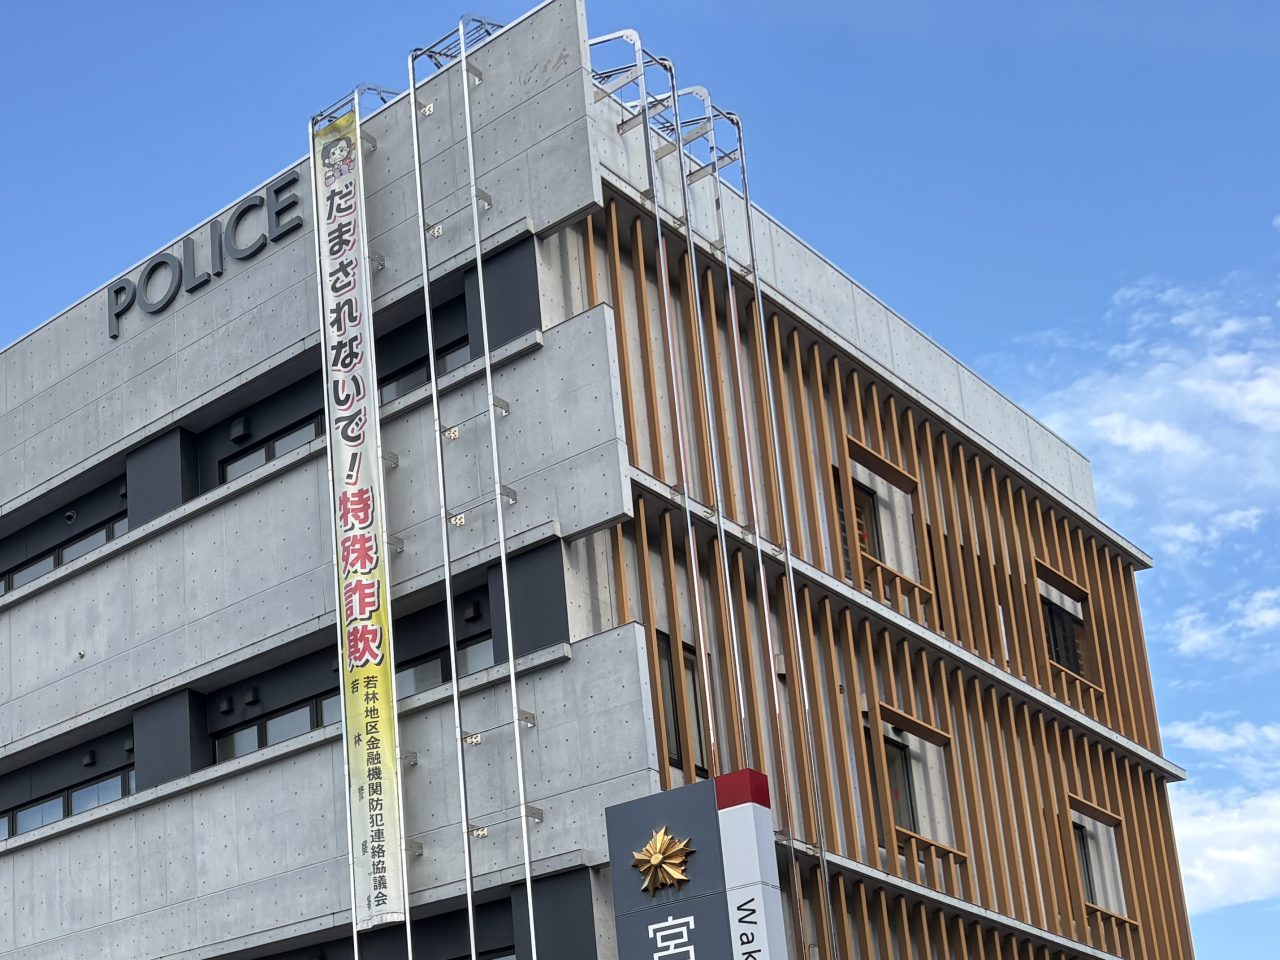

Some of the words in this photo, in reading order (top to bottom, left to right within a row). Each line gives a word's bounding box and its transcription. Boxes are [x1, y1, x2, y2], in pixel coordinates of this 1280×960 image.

[108, 170, 304, 339] POLICE
[363, 675, 388, 907] 若林地区金融機関防犯連絡協議会
